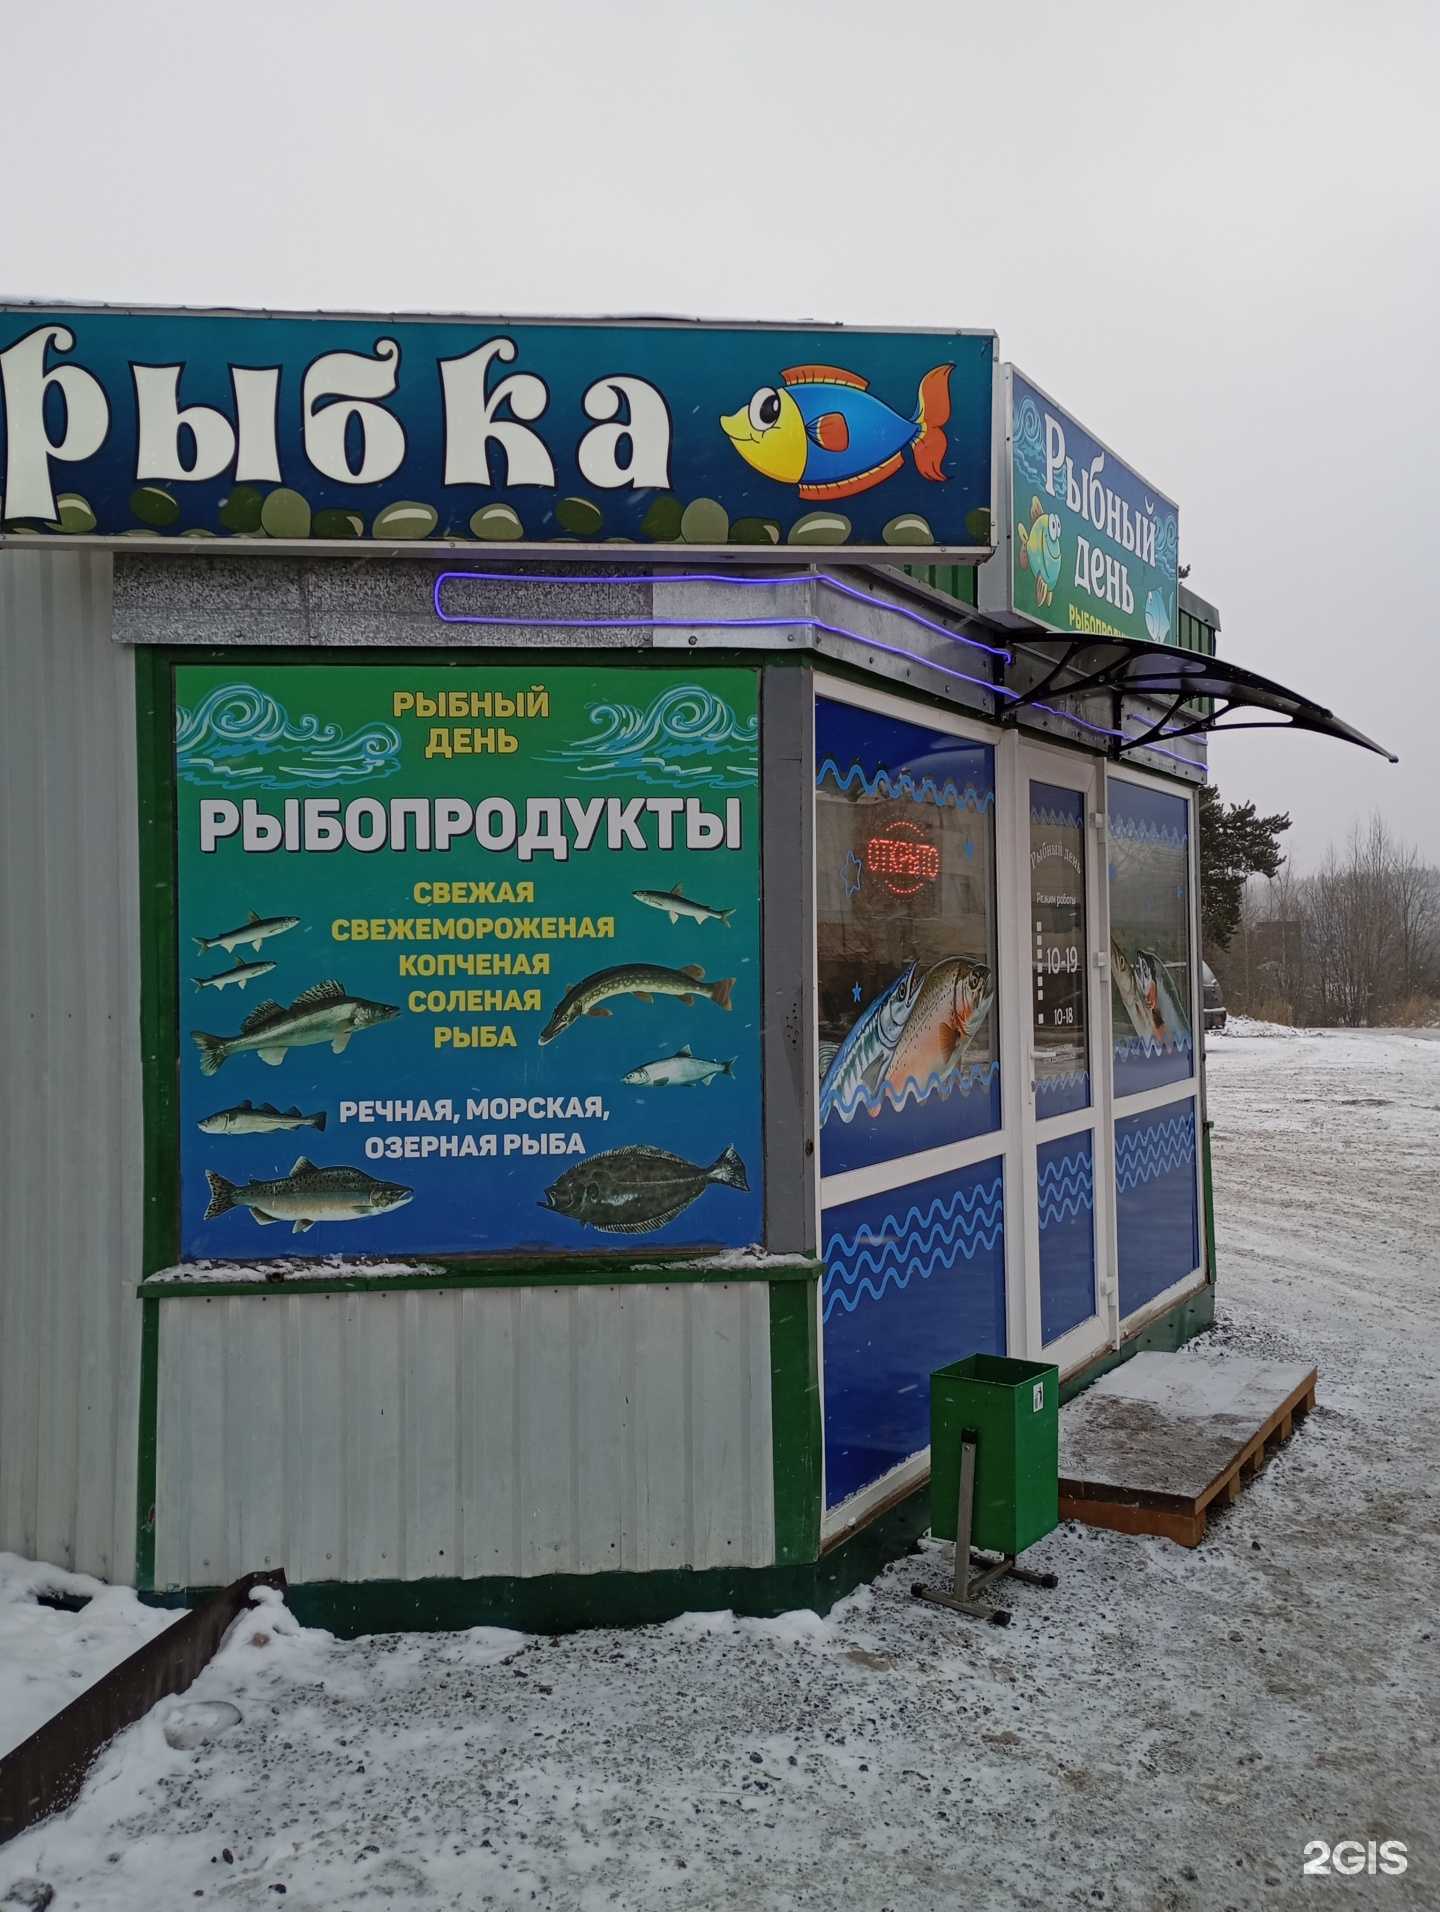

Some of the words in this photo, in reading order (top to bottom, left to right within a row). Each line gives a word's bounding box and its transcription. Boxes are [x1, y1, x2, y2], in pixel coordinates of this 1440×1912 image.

[393, 684, 550, 719] РЫБНЫЙ
[424, 726, 520, 759] ДЕНЬ
[199, 797, 743, 862] РЫБОПРОДУКТЫ
[413, 881, 535, 904] СВЕЖАЯ
[331, 916, 615, 942] СВЕЖЕМОРОЖЕНАЯ
[399, 953, 550, 977] КОПЧЕНАЯ
[1046, 946, 1078, 974] 10-19
[407, 989, 542, 1013] СОЛЕНАЯ
[1054, 1007, 1074, 1025] 10-18
[433, 1025, 518, 1049] РЫБА
[339, 1099, 460, 1126] РЕЧНАЯ,
[466, 1096, 611, 1121] МОРСКАЯ,
[364, 1135, 498, 1160] ОЗЕРНАЯ
[503, 1132, 587, 1156] РЫБА
